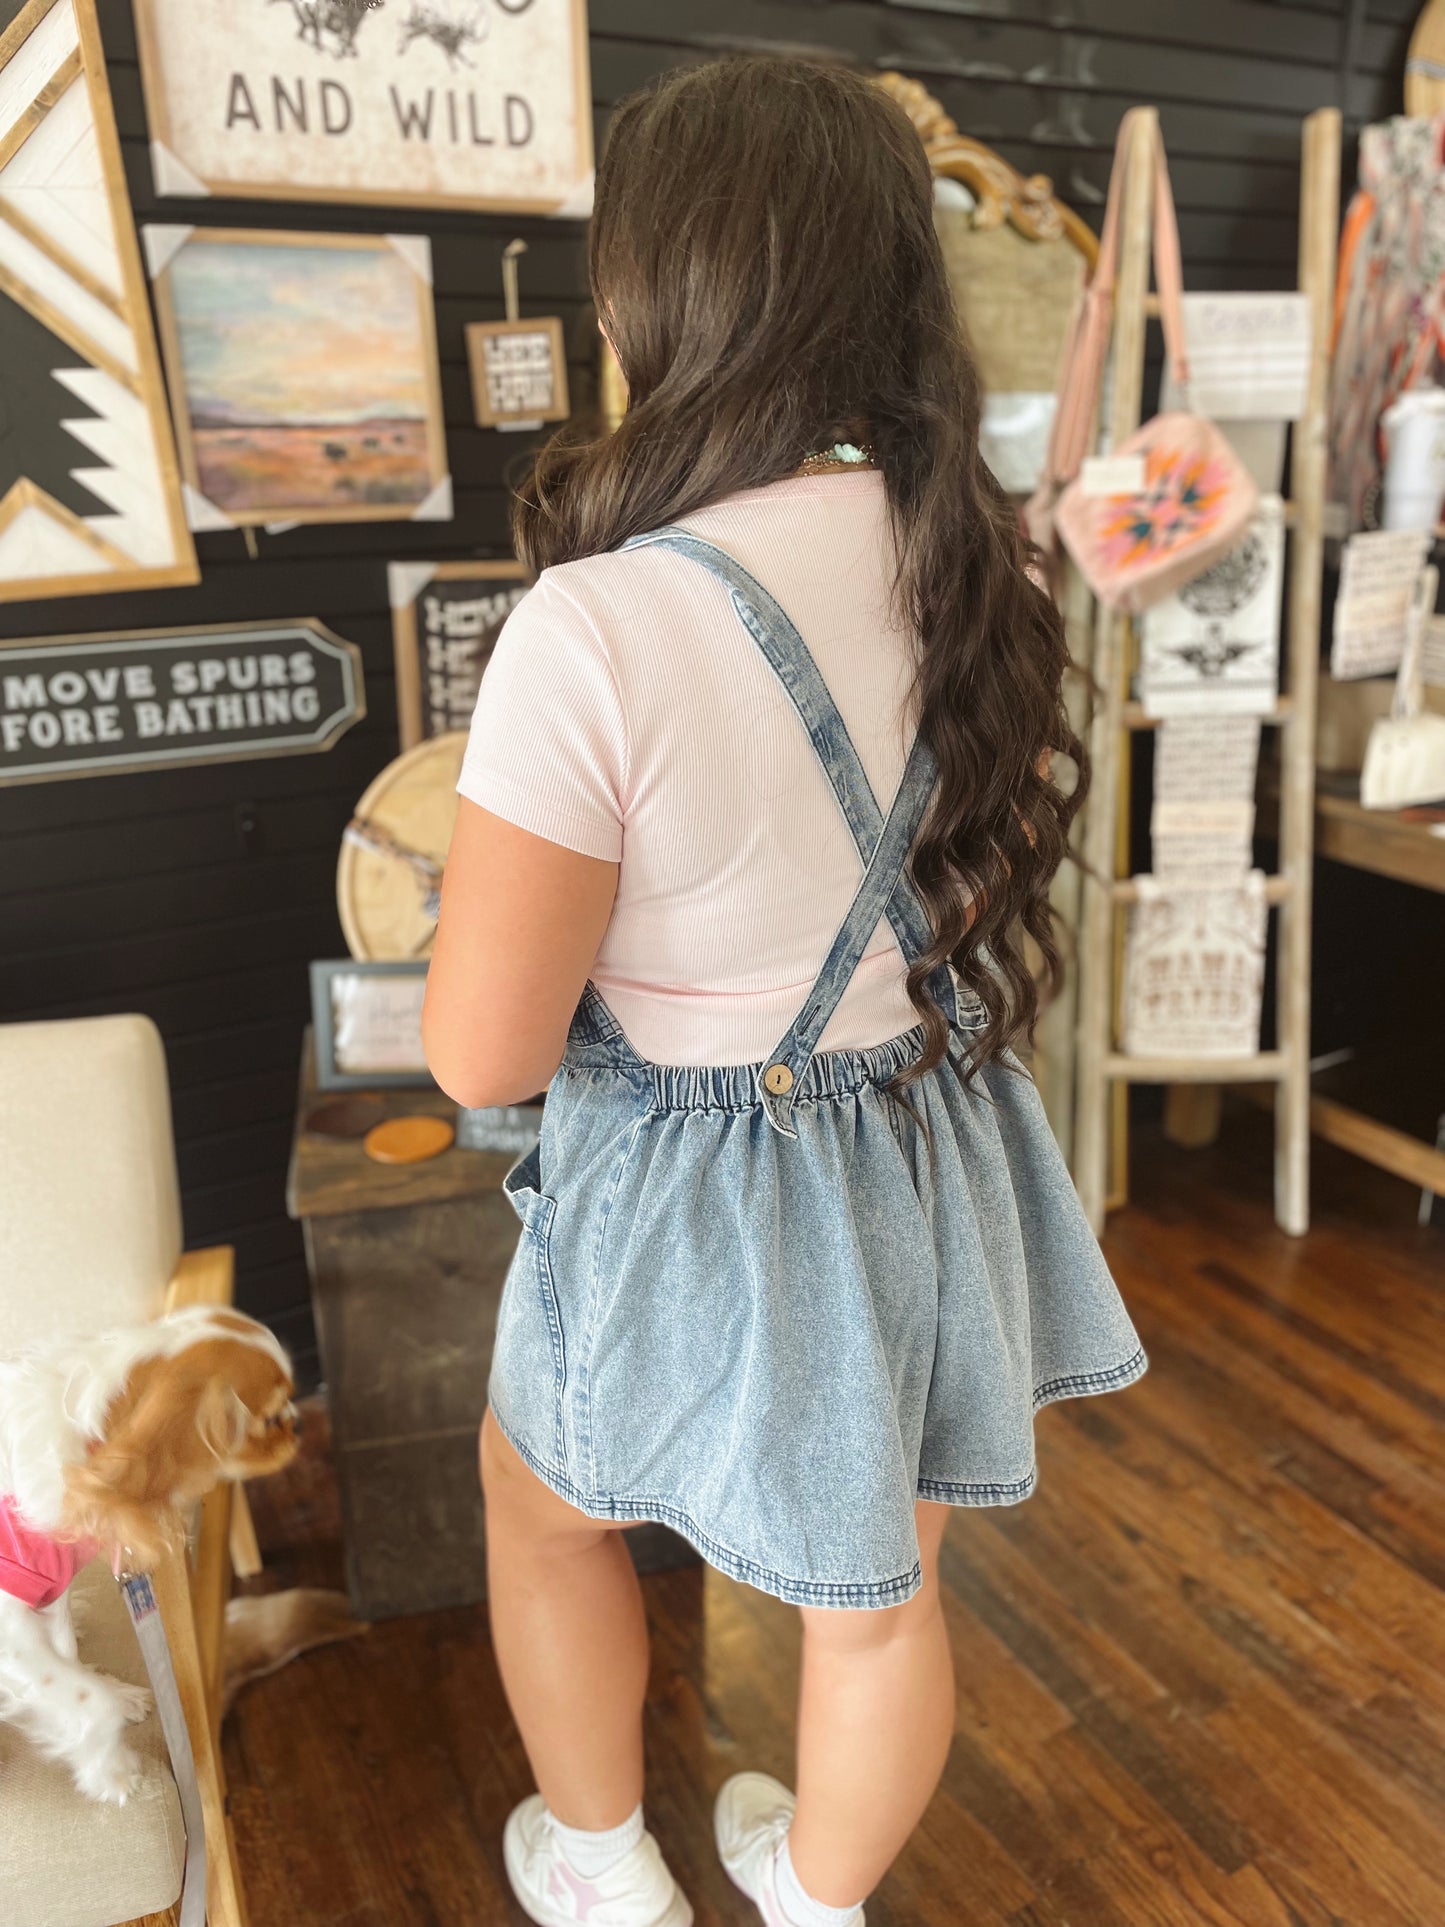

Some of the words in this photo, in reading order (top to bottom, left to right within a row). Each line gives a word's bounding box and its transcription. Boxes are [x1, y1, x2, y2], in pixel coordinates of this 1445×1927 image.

[226, 72, 352, 135] AND
[389, 84, 534, 146] WILD
[3, 664, 156, 710] MOVE
[170, 651, 316, 695] SPURS
[0, 705, 124, 752] FORE
[133, 686, 320, 739] BATHING
